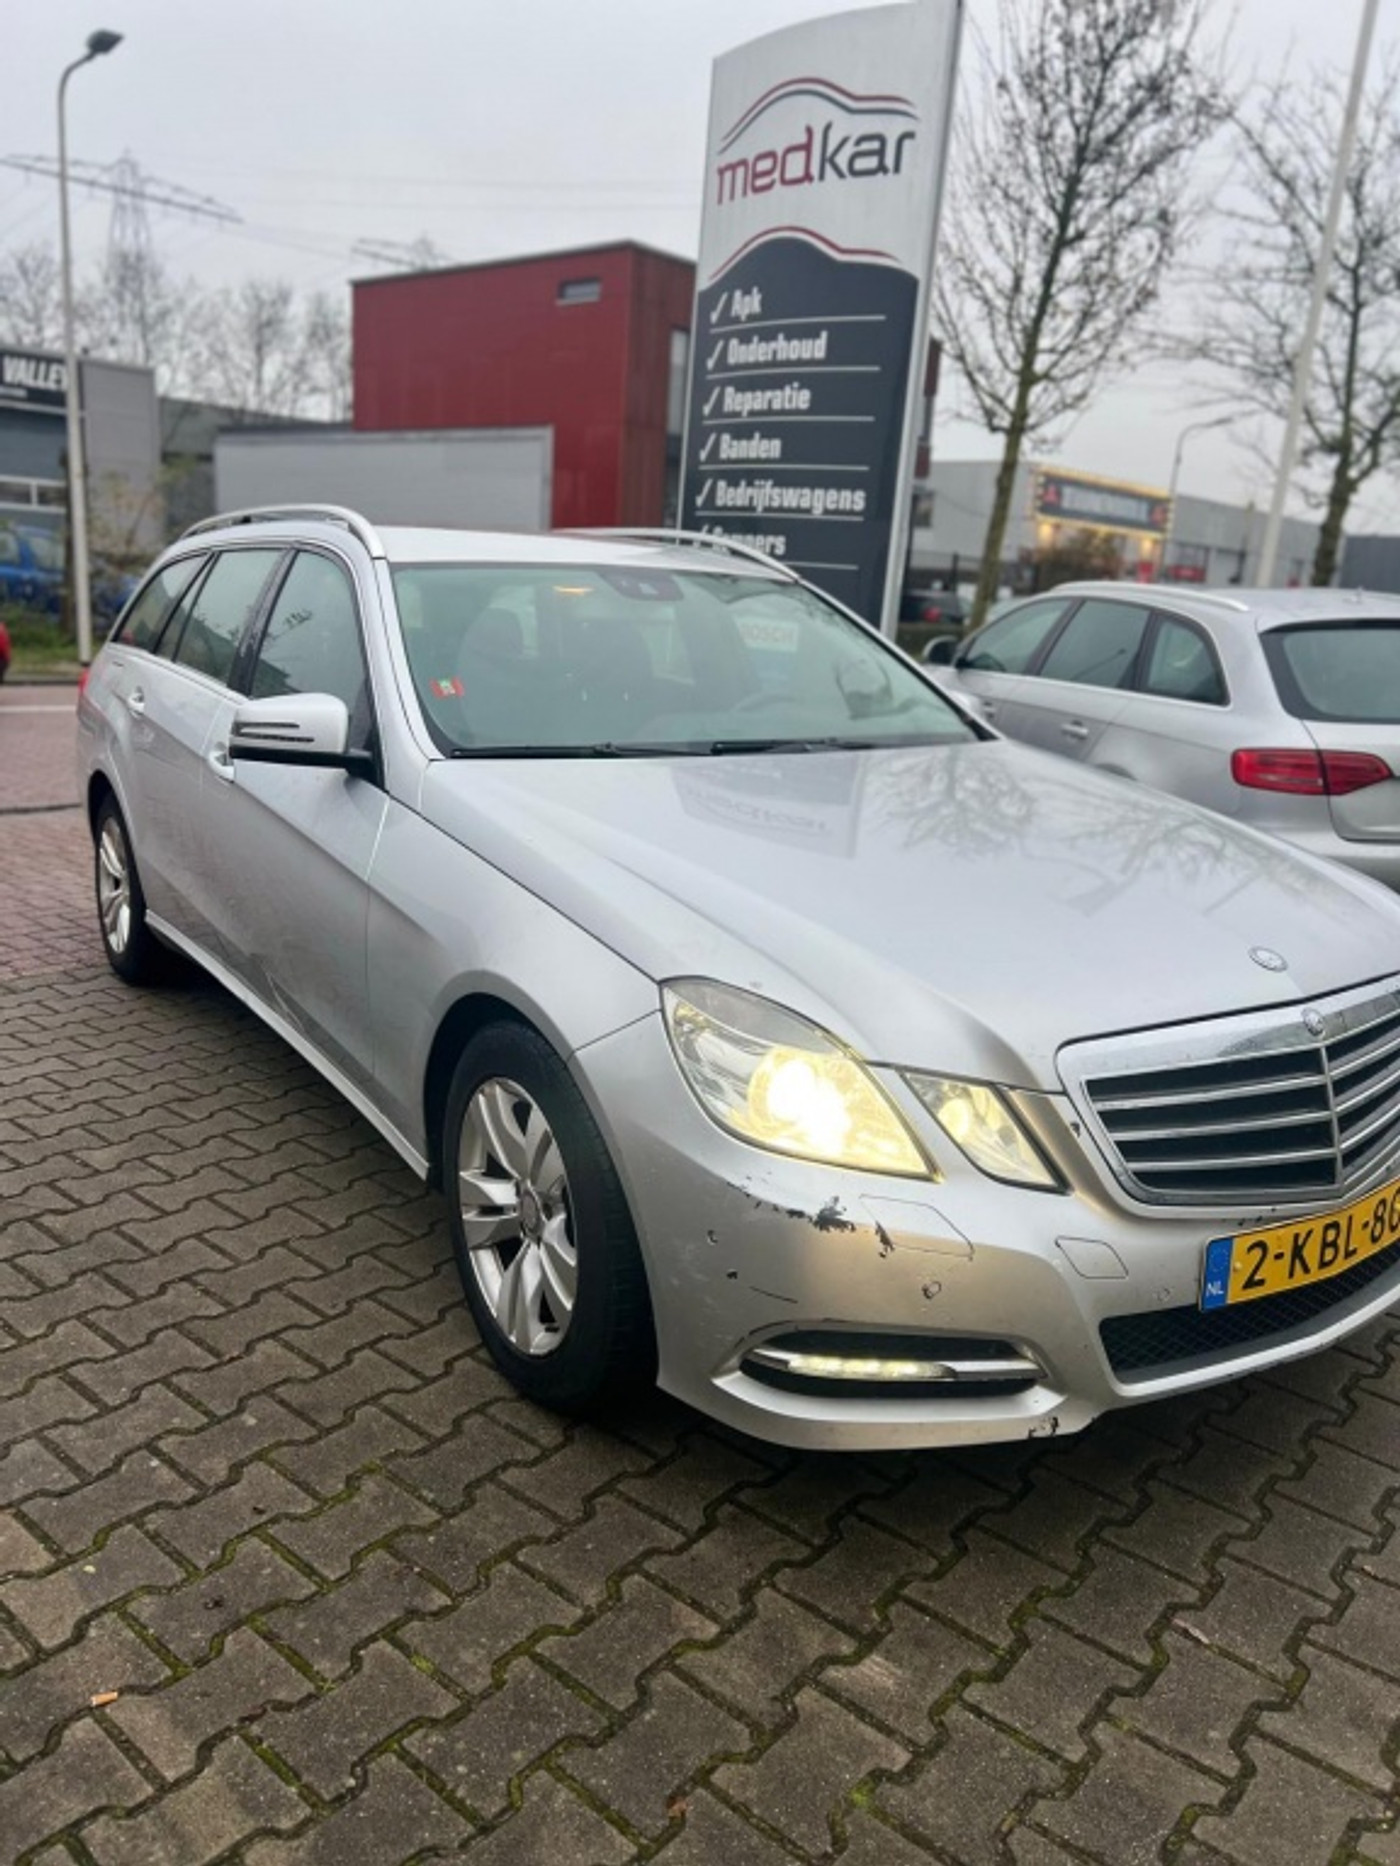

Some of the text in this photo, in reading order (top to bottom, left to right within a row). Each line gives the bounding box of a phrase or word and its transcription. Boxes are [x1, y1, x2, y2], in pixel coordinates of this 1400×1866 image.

[716, 120, 916, 206] medkar
[731, 286, 762, 321] Apk
[727, 330, 828, 366] Onderhoud
[3, 355, 69, 392] VALLE
[723, 382, 812, 417] Reparatie
[719, 432, 782, 460] Banden
[715, 479, 867, 515] Bedrijfswagens
[1205, 1281, 1225, 1298] NL
